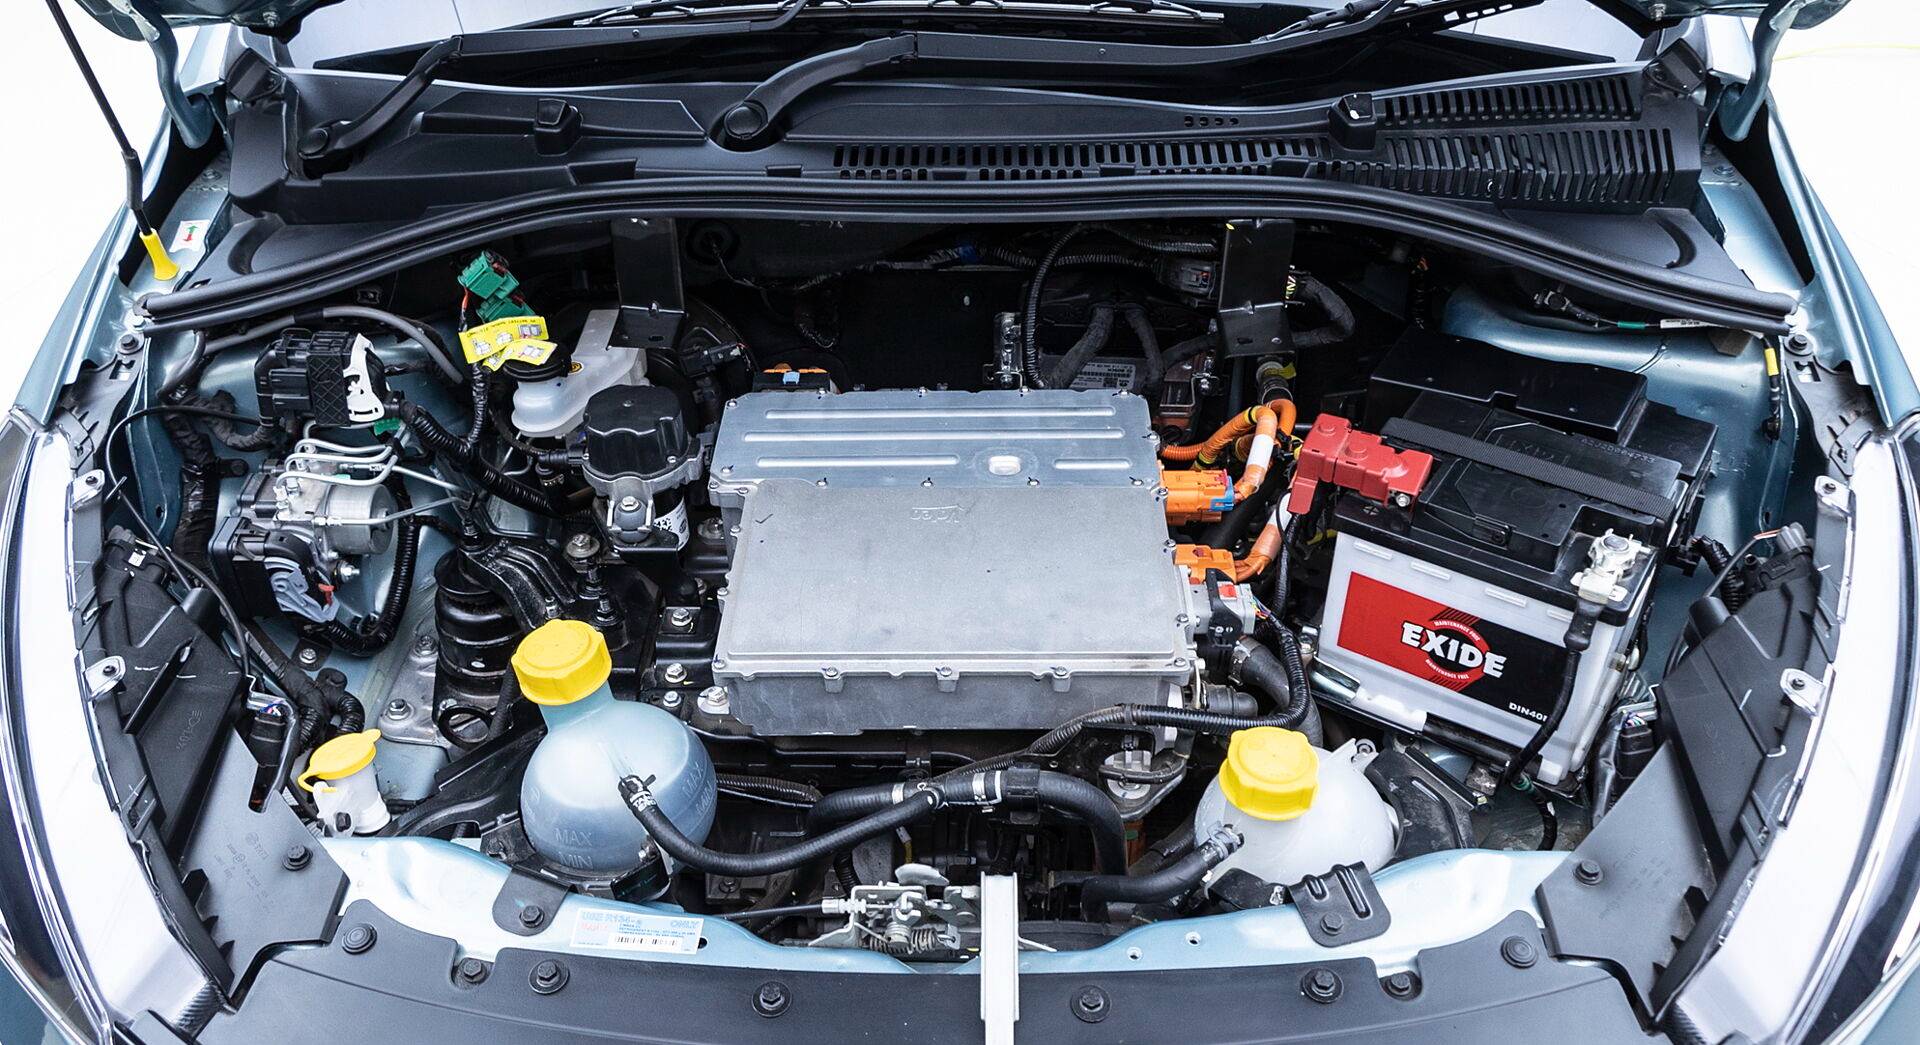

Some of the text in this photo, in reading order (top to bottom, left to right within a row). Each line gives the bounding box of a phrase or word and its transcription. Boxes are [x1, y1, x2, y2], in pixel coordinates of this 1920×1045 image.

[1433, 619, 1481, 642] MAINTENANCE FREE
[1401, 621, 1507, 678] EXIDE
[1425, 658, 1457, 680] MAINTENANCE
[552, 827, 593, 847] MAX
[558, 851, 594, 870] MIN
